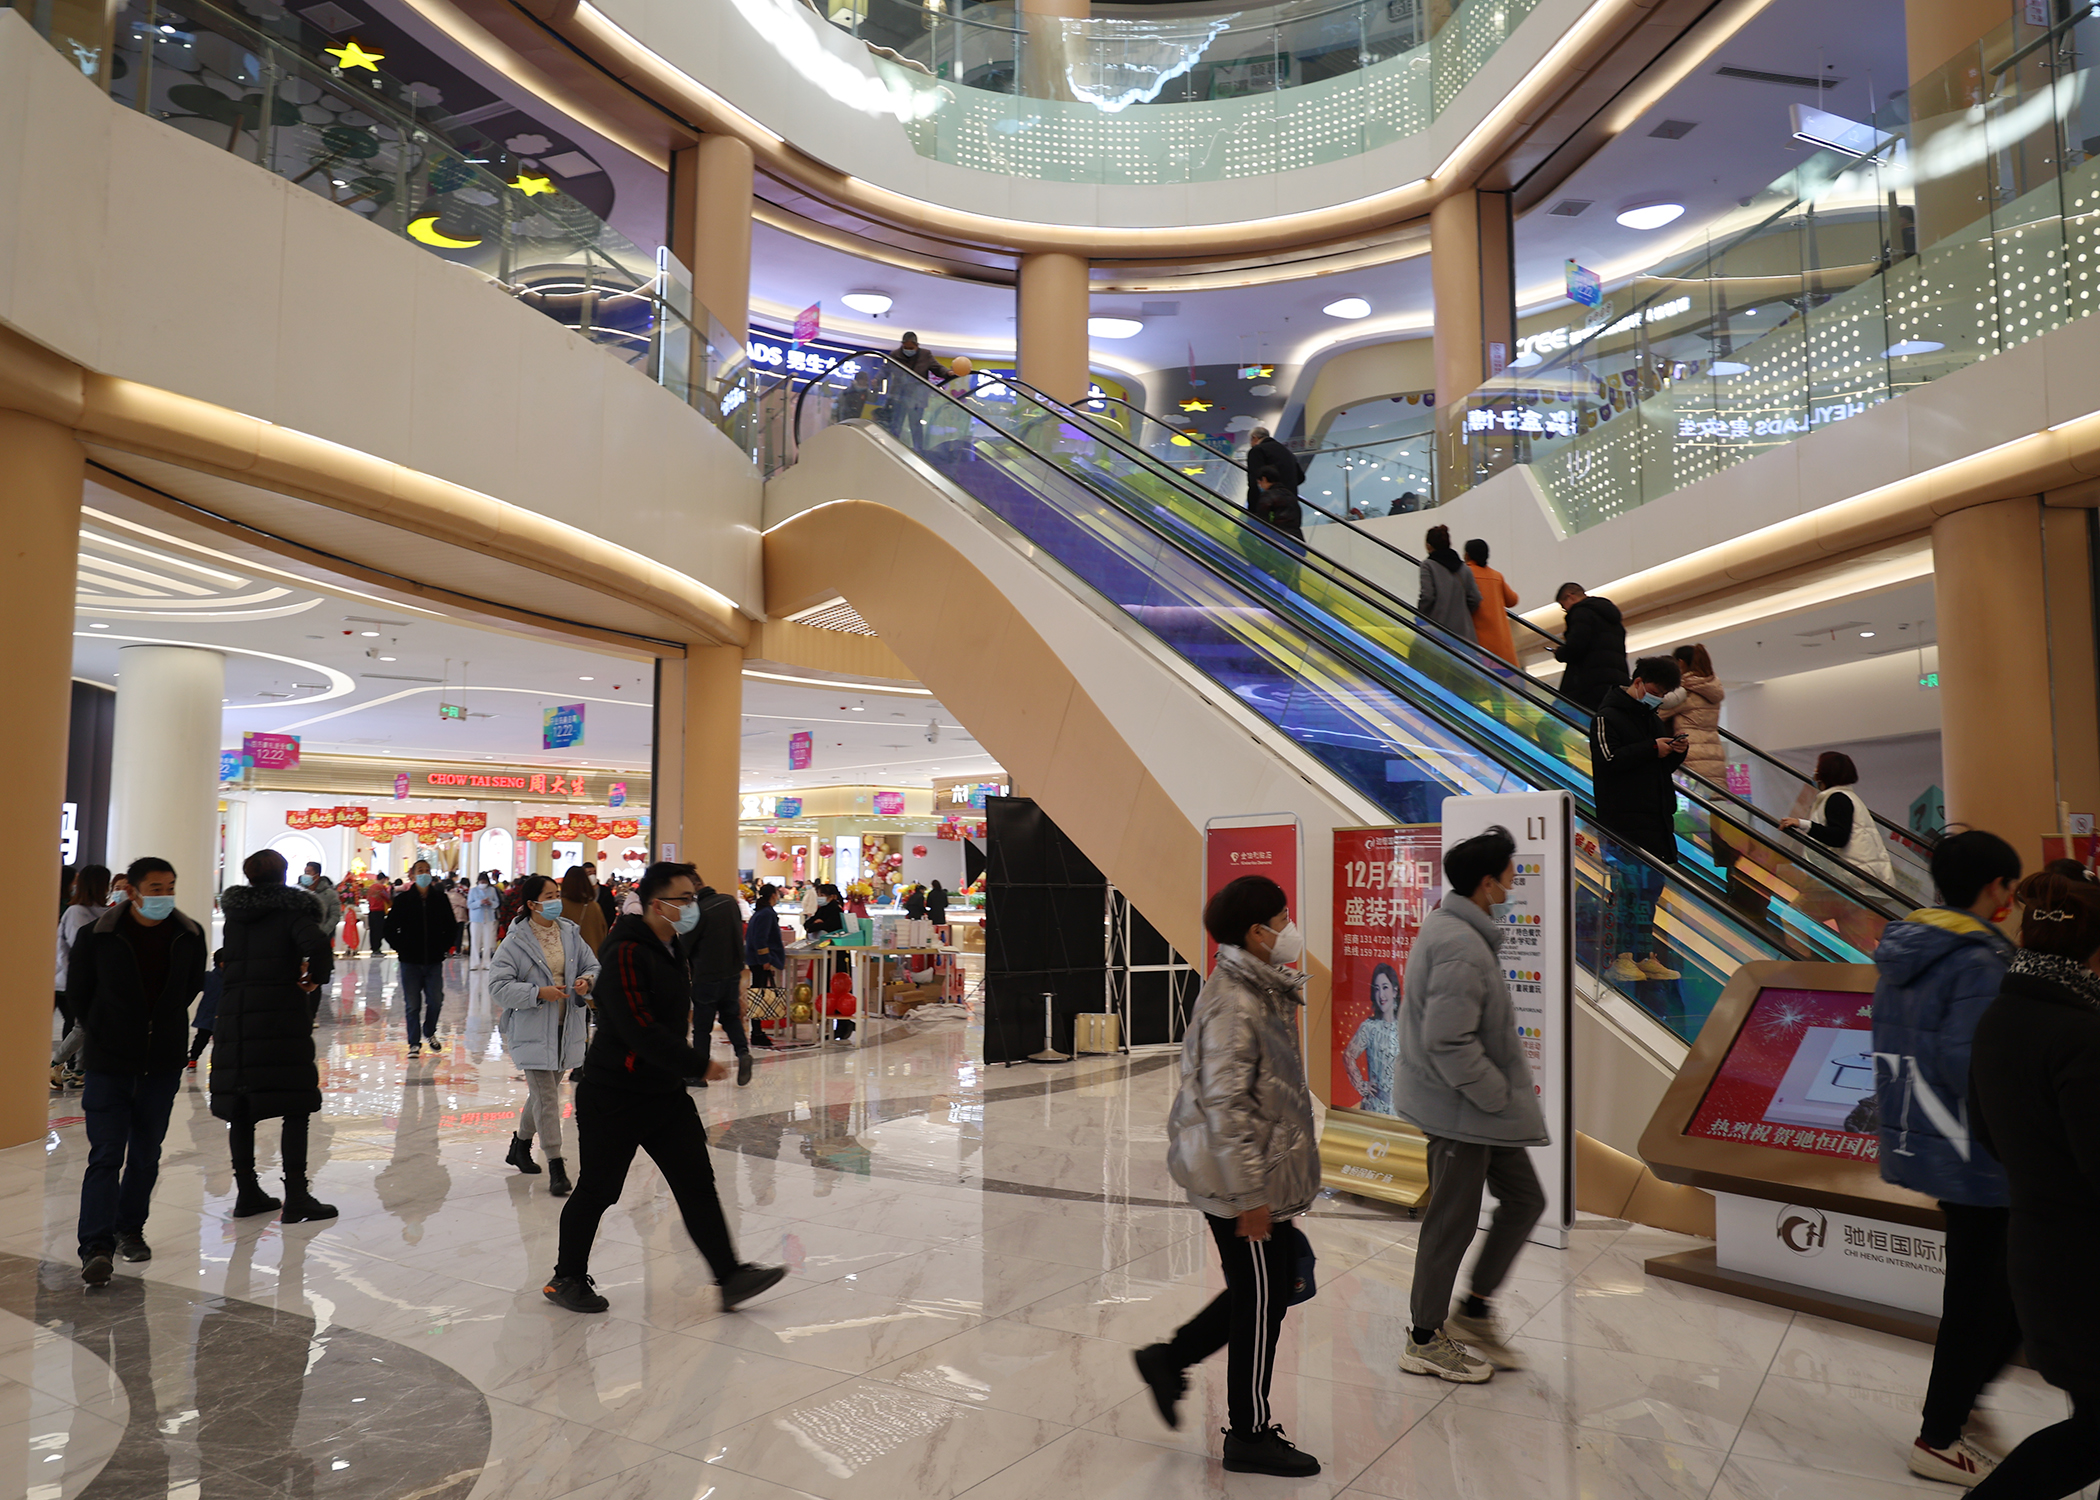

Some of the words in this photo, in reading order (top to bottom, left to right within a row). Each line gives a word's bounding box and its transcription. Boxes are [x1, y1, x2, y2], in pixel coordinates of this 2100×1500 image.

[787, 350, 861, 379] 男生女生
[427, 773, 468, 786] CHOW
[469, 775, 491, 787] TAI
[491, 776, 525, 789] SENG
[528, 773, 586, 797] 周大生
[1527, 816, 1546, 841] L1
[1344, 896, 1433, 928] 盛装开业
[1843, 1247, 1858, 1258] CHI
[1860, 1251, 1885, 1264] HENG
